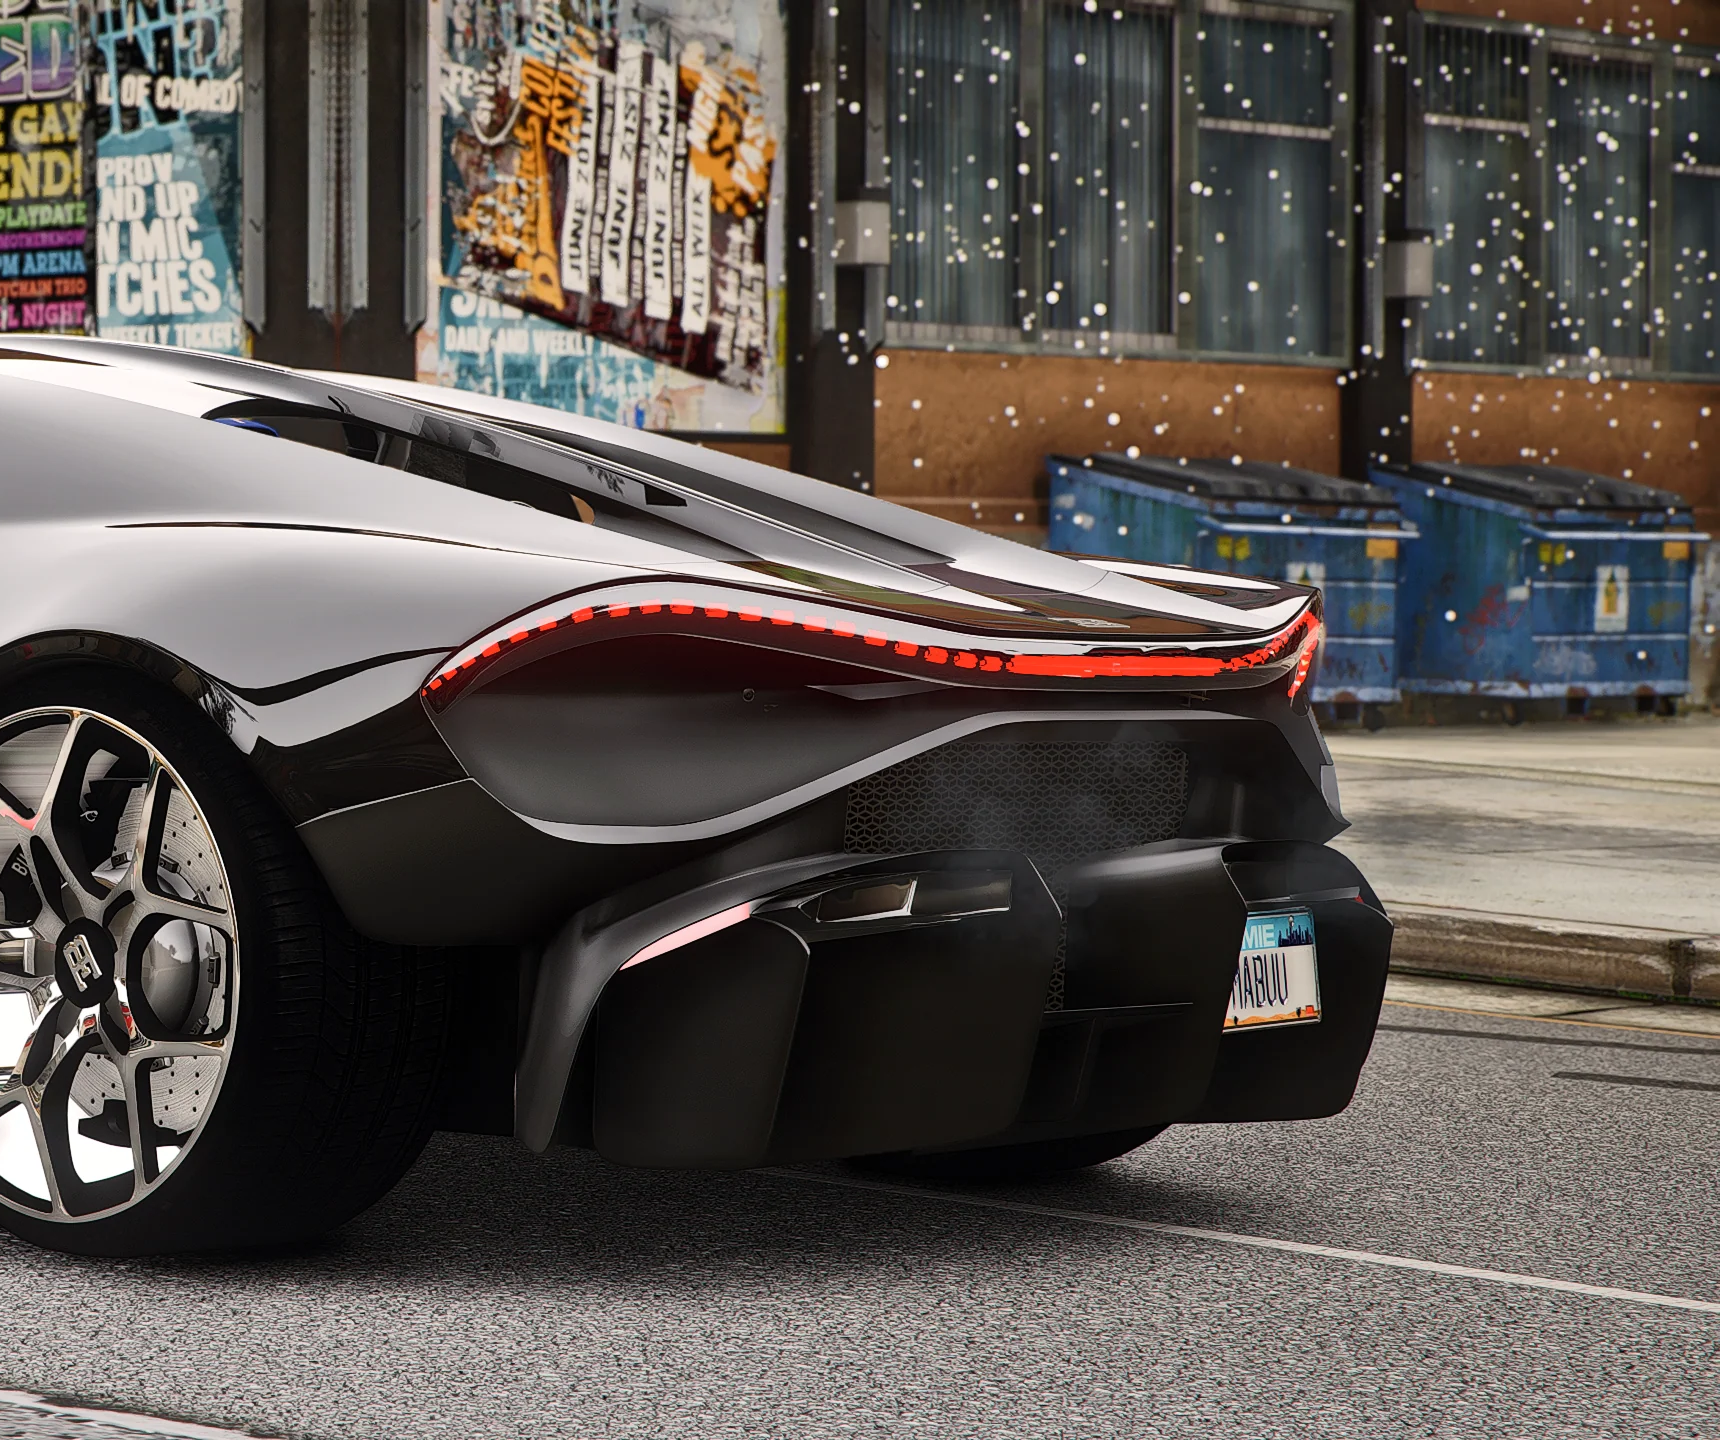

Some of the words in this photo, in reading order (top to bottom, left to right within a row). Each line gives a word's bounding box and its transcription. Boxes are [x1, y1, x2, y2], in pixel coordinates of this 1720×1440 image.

[121, 73, 152, 107] OF
[11, 101, 86, 145] GAY
[686, 66, 726, 155] NIGH
[98, 153, 173, 187] PROV
[154, 181, 199, 218] UP
[131, 217, 204, 262] MIC
[22, 249, 87, 276] ARENA
[22, 301, 87, 327] NIGHT
